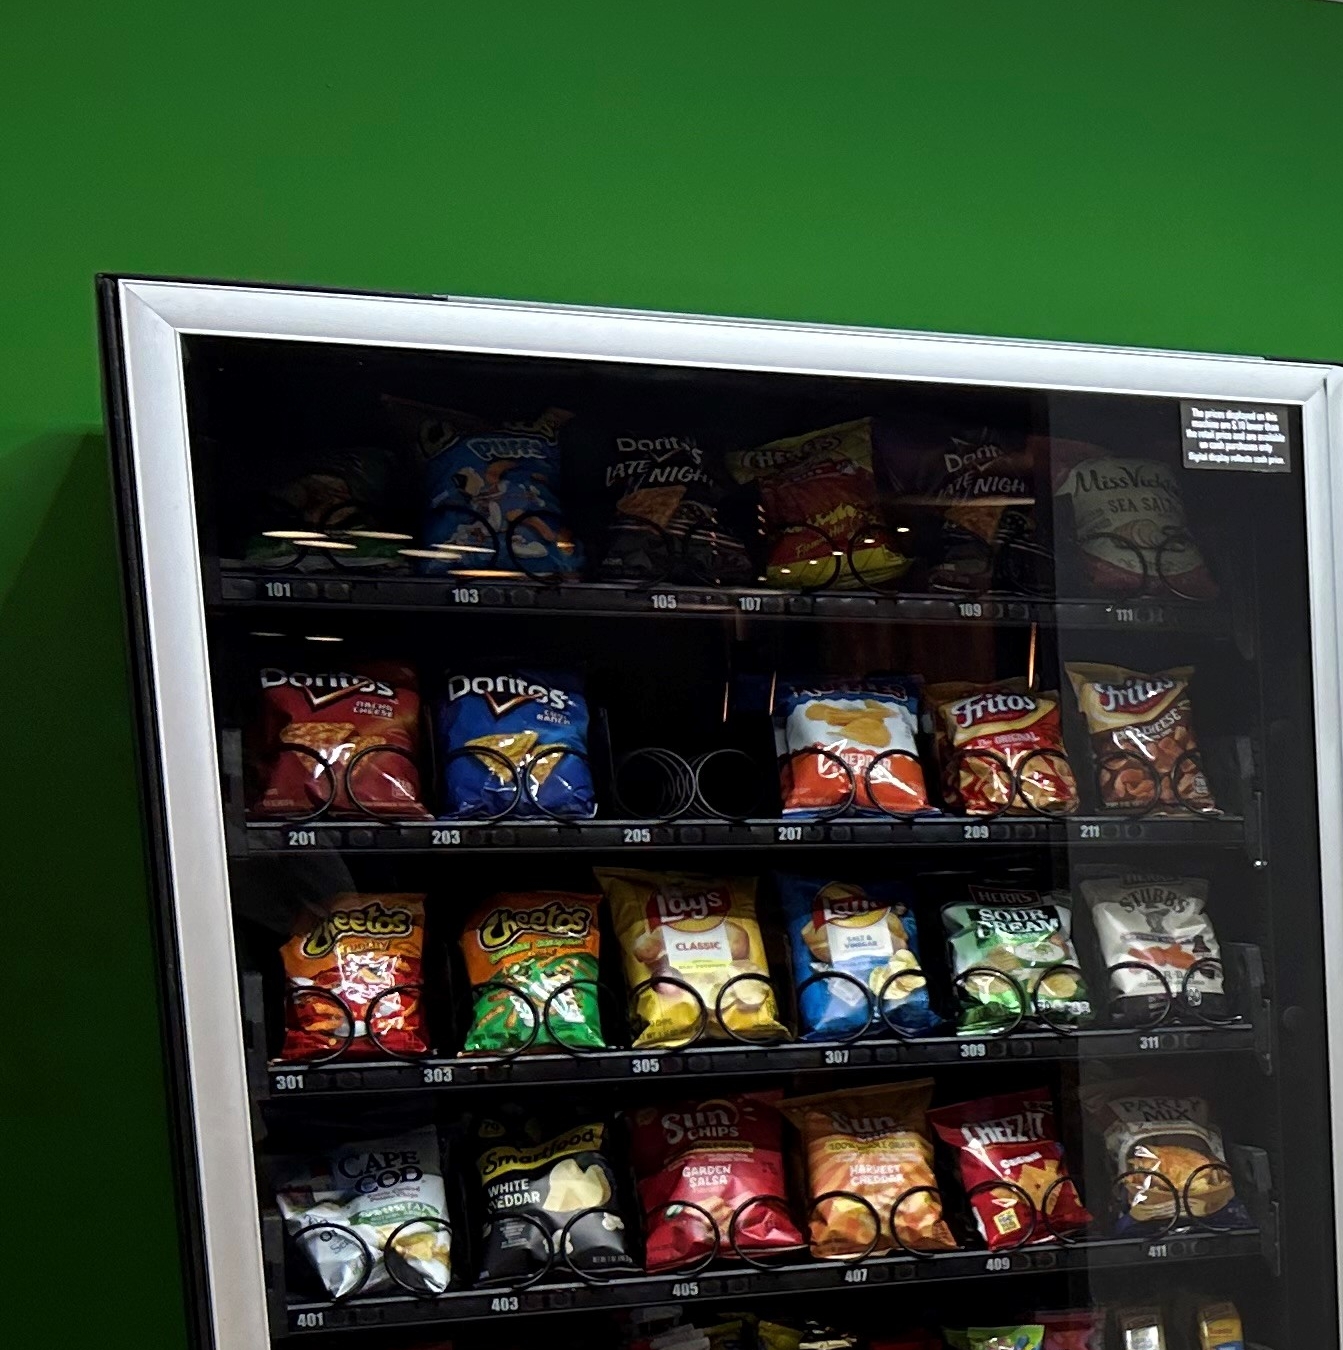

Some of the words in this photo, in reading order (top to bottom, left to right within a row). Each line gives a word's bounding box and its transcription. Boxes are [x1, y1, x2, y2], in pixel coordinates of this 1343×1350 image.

[974, 474, 1026, 494] NIGH
[1074, 469, 1128, 497] Miss
[1108, 499, 1139, 514] SEA
[265, 582, 291, 597] 101
[451, 588, 479, 604] 103
[651, 594, 678, 609] 105
[738, 597, 761, 611] 107
[958, 603, 982, 617] 109
[1115, 608, 1134, 622] 111
[260, 667, 395, 698] Doritos
[449, 674, 568, 711] Doritos
[1091, 676, 1175, 712] Fritos
[951, 692, 1037, 728] Fritos
[288, 831, 316, 846] 201
[431, 829, 461, 845] 203
[624, 828, 651, 843] 205
[778, 826, 802, 841] 207
[964, 825, 989, 839] 209
[1080, 824, 1100, 838] 211
[978, 907, 1050, 922] SOUR
[303, 903, 412, 957] Cheetos
[478, 902, 591, 949] Cheetos
[976, 916, 1060, 939] CREAM
[675, 940, 722, 952] CLASSIC
[960, 1043, 986, 1057] 309
[1140, 1036, 1159, 1049] 311
[825, 1050, 849, 1064] 307
[632, 1058, 660, 1073] 305
[275, 1074, 304, 1090] 301
[423, 1066, 454, 1083] 303
[830, 1110, 898, 1133] Sun
[1143, 1108, 1192, 1123] MIX
[661, 1108, 731, 1145] Sun
[687, 1124, 741, 1141] CHIPS
[482, 1128, 595, 1176] Smartfood
[338, 1151, 420, 1179] CAPE
[682, 1163, 732, 1177] GARDEN
[354, 1165, 424, 1194] COD
[689, 1174, 729, 1188] SALSA
[487, 1177, 530, 1199] WHITE
[1148, 1244, 1167, 1257] 411
[986, 1257, 1010, 1271] 409
[844, 1268, 868, 1283] 407
[672, 1282, 699, 1297] 405
[491, 1296, 519, 1311] 403
[297, 1312, 324, 1327] 401
